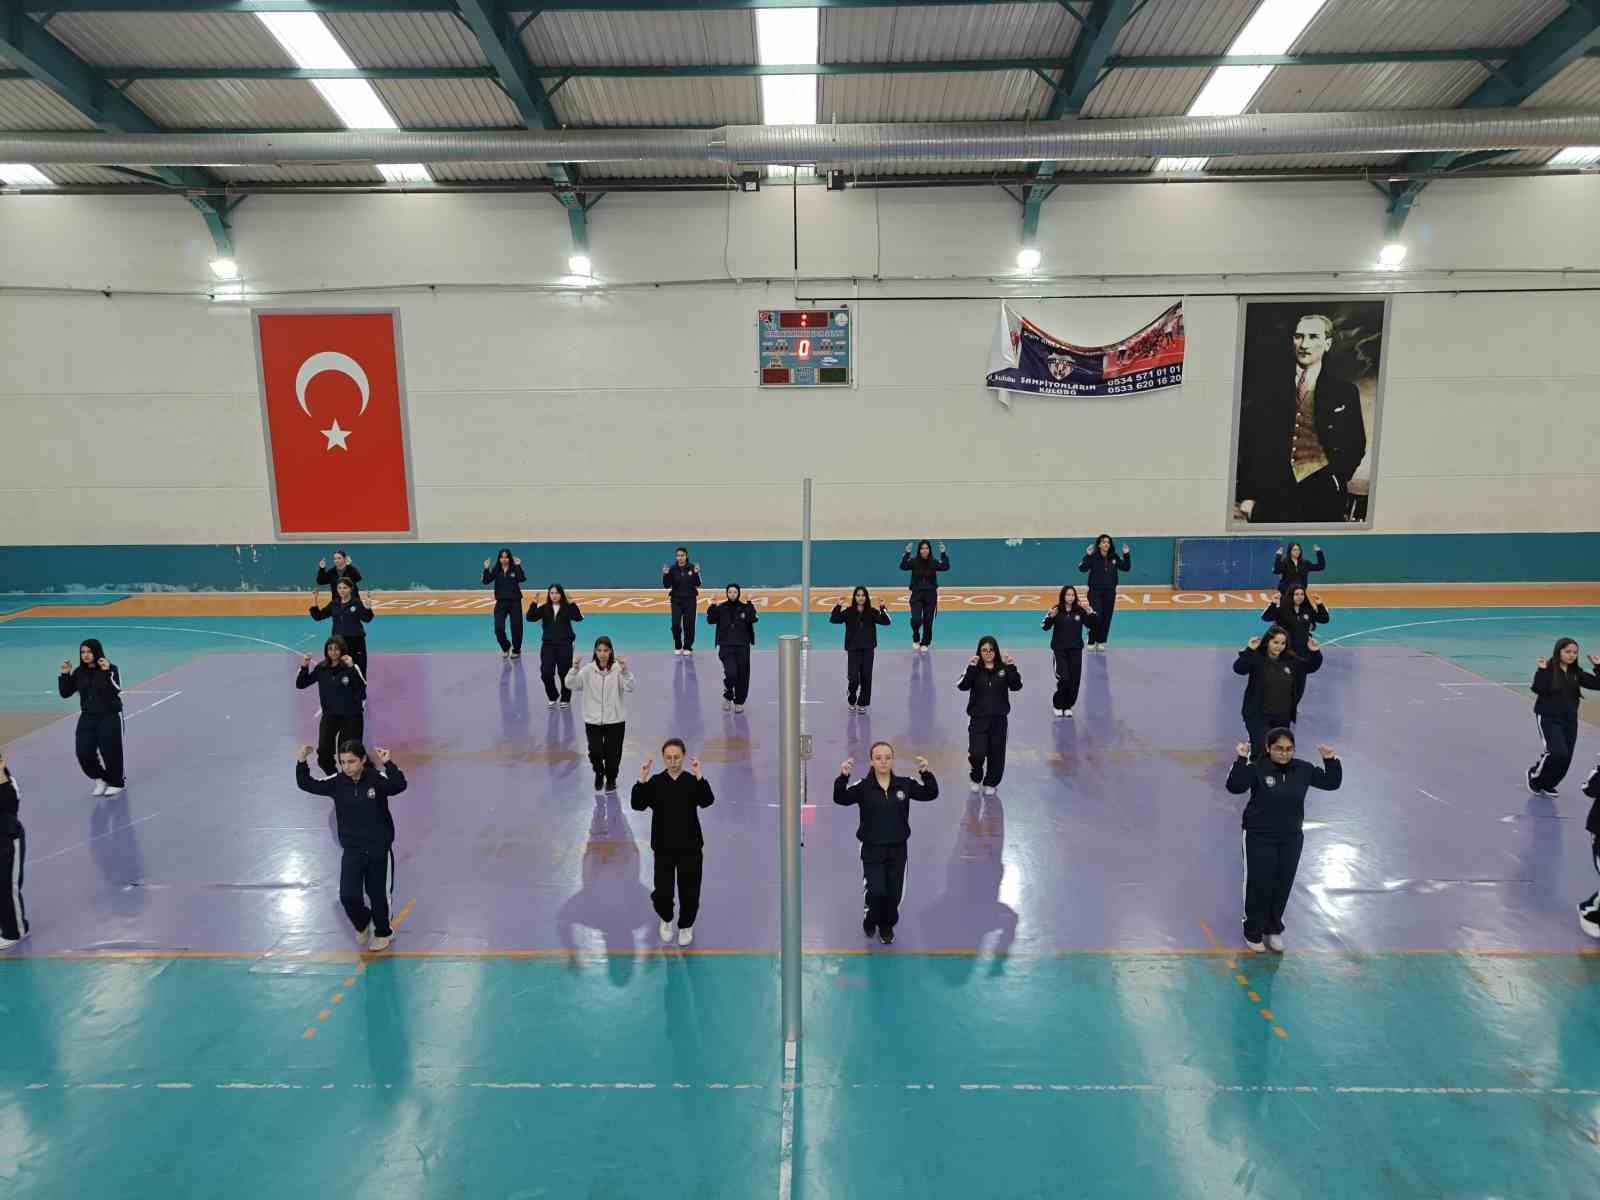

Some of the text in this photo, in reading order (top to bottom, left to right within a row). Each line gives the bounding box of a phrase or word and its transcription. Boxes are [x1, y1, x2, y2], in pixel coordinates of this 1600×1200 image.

[798, 339, 810, 357] 0
[1107, 364, 1181, 386] 0534 571 01 01
[1107, 373, 1182, 394] 0533 620 16 20
